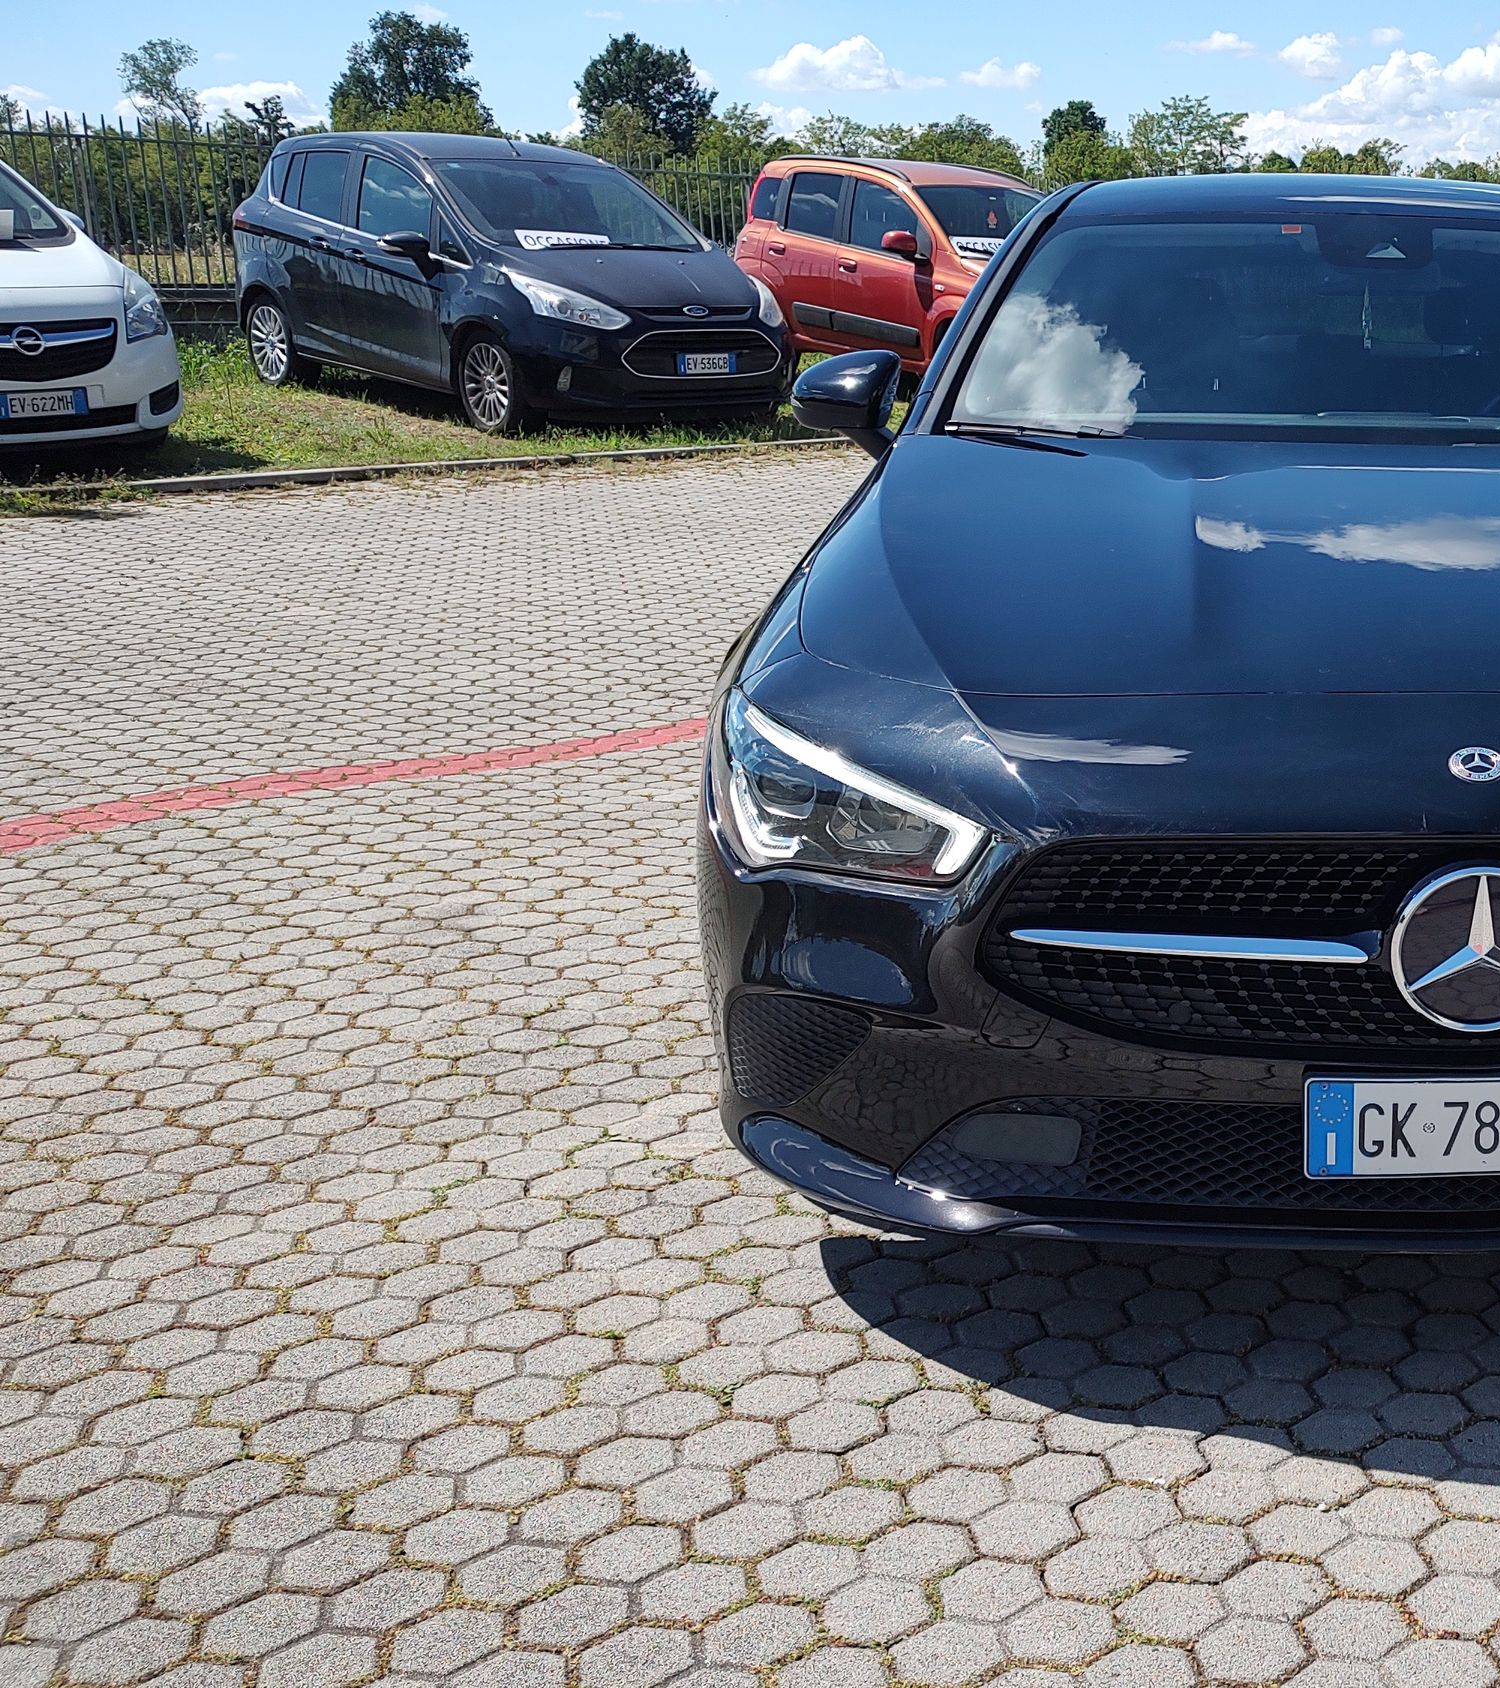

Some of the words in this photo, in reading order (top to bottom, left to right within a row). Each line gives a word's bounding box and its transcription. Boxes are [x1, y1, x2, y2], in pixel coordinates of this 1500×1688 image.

[686, 357, 698, 371] EV
[9, 397, 26, 414] EV
[31, 394, 74, 413] 622MH
[1357, 1102, 1418, 1159] GK
